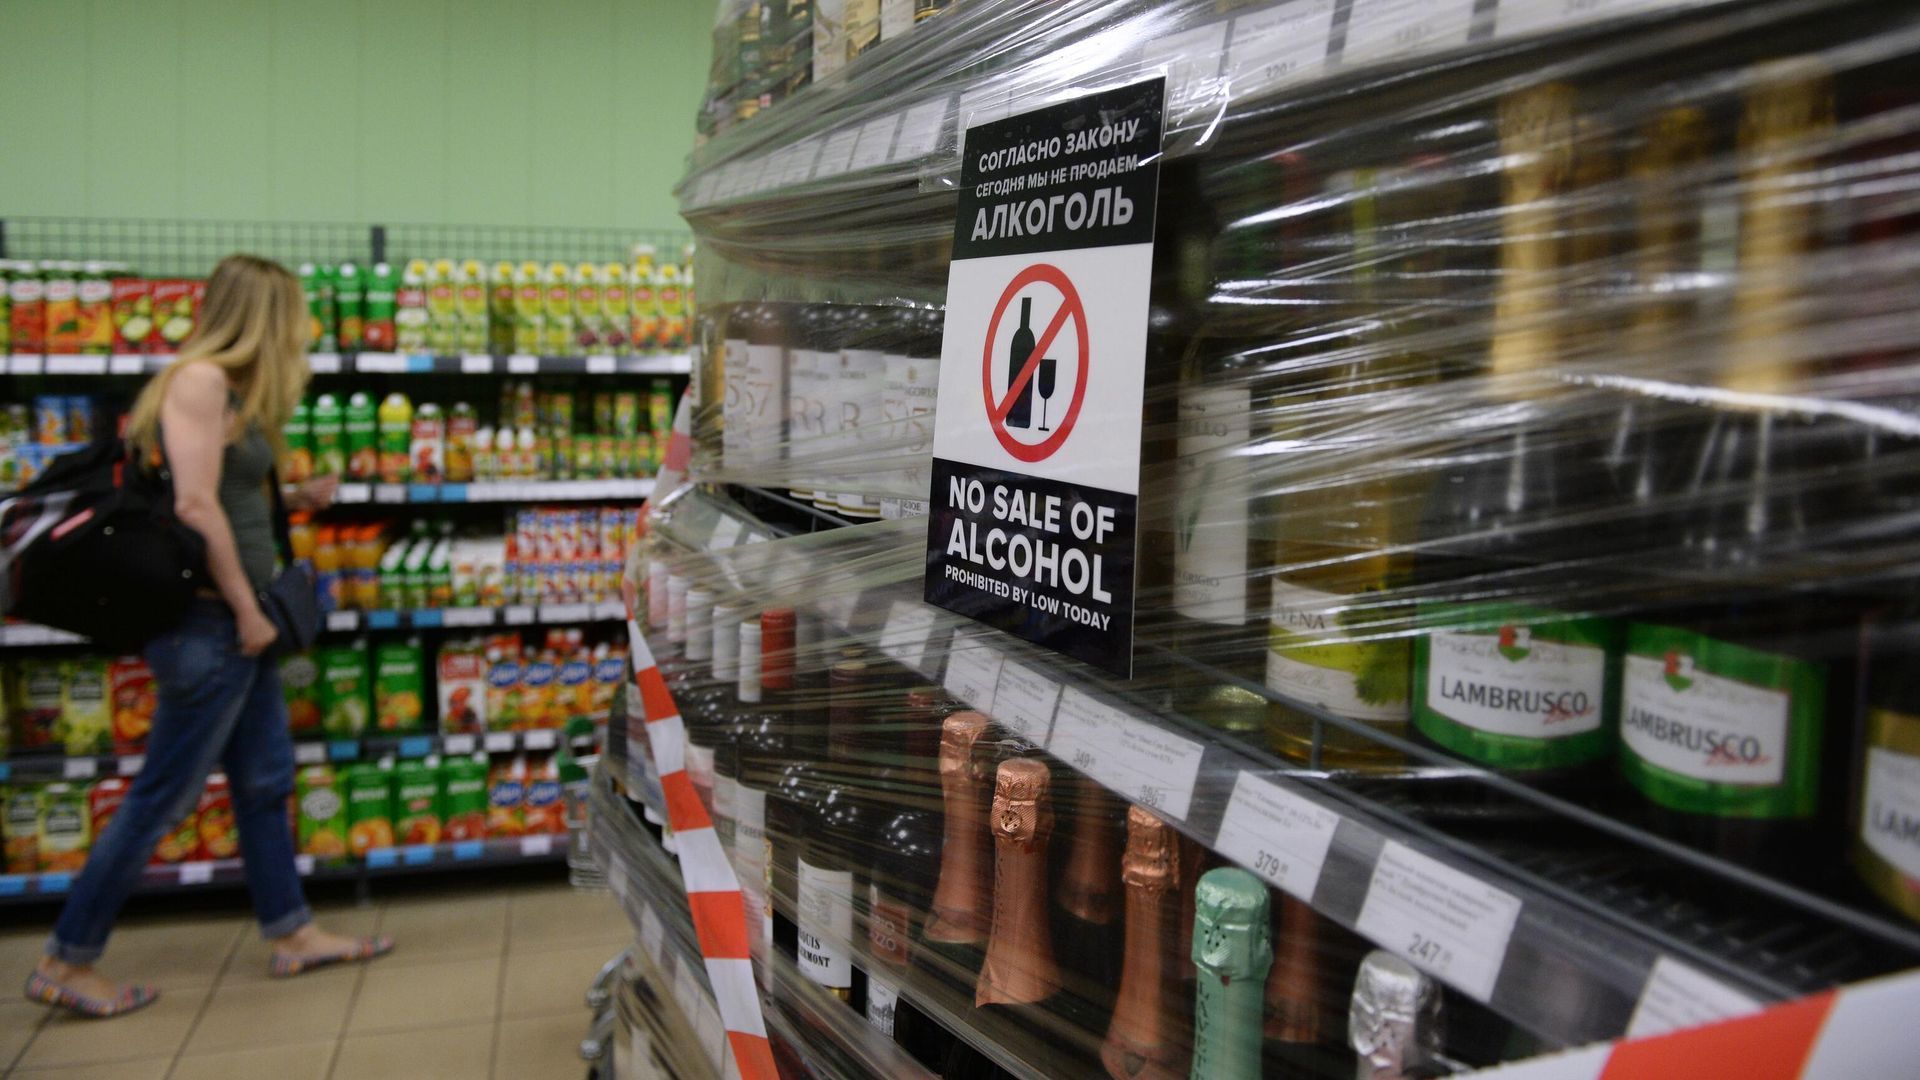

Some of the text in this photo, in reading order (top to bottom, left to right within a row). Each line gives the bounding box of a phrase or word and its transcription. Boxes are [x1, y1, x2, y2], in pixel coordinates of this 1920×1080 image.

[979, 118, 1140, 173] СОГЛАСНО ЗАКОНУ
[976, 154, 1138, 198] СЕГОДНЯ МЫ НЕ ПРОДАЕМ
[971, 186, 1134, 242] АЛКОГОЛЬ
[949, 475, 1115, 544] NO SALE OF
[946, 518, 1112, 604] ALCOHOL
[945, 565, 1111, 631] PROHIBITED BY LOW TODAY
[1440, 675, 1588, 716] LAMBRUSCO
[1073, 748, 1091, 769] 349
[1255, 849, 1280, 877] 379
[1408, 932, 1441, 963] 247
